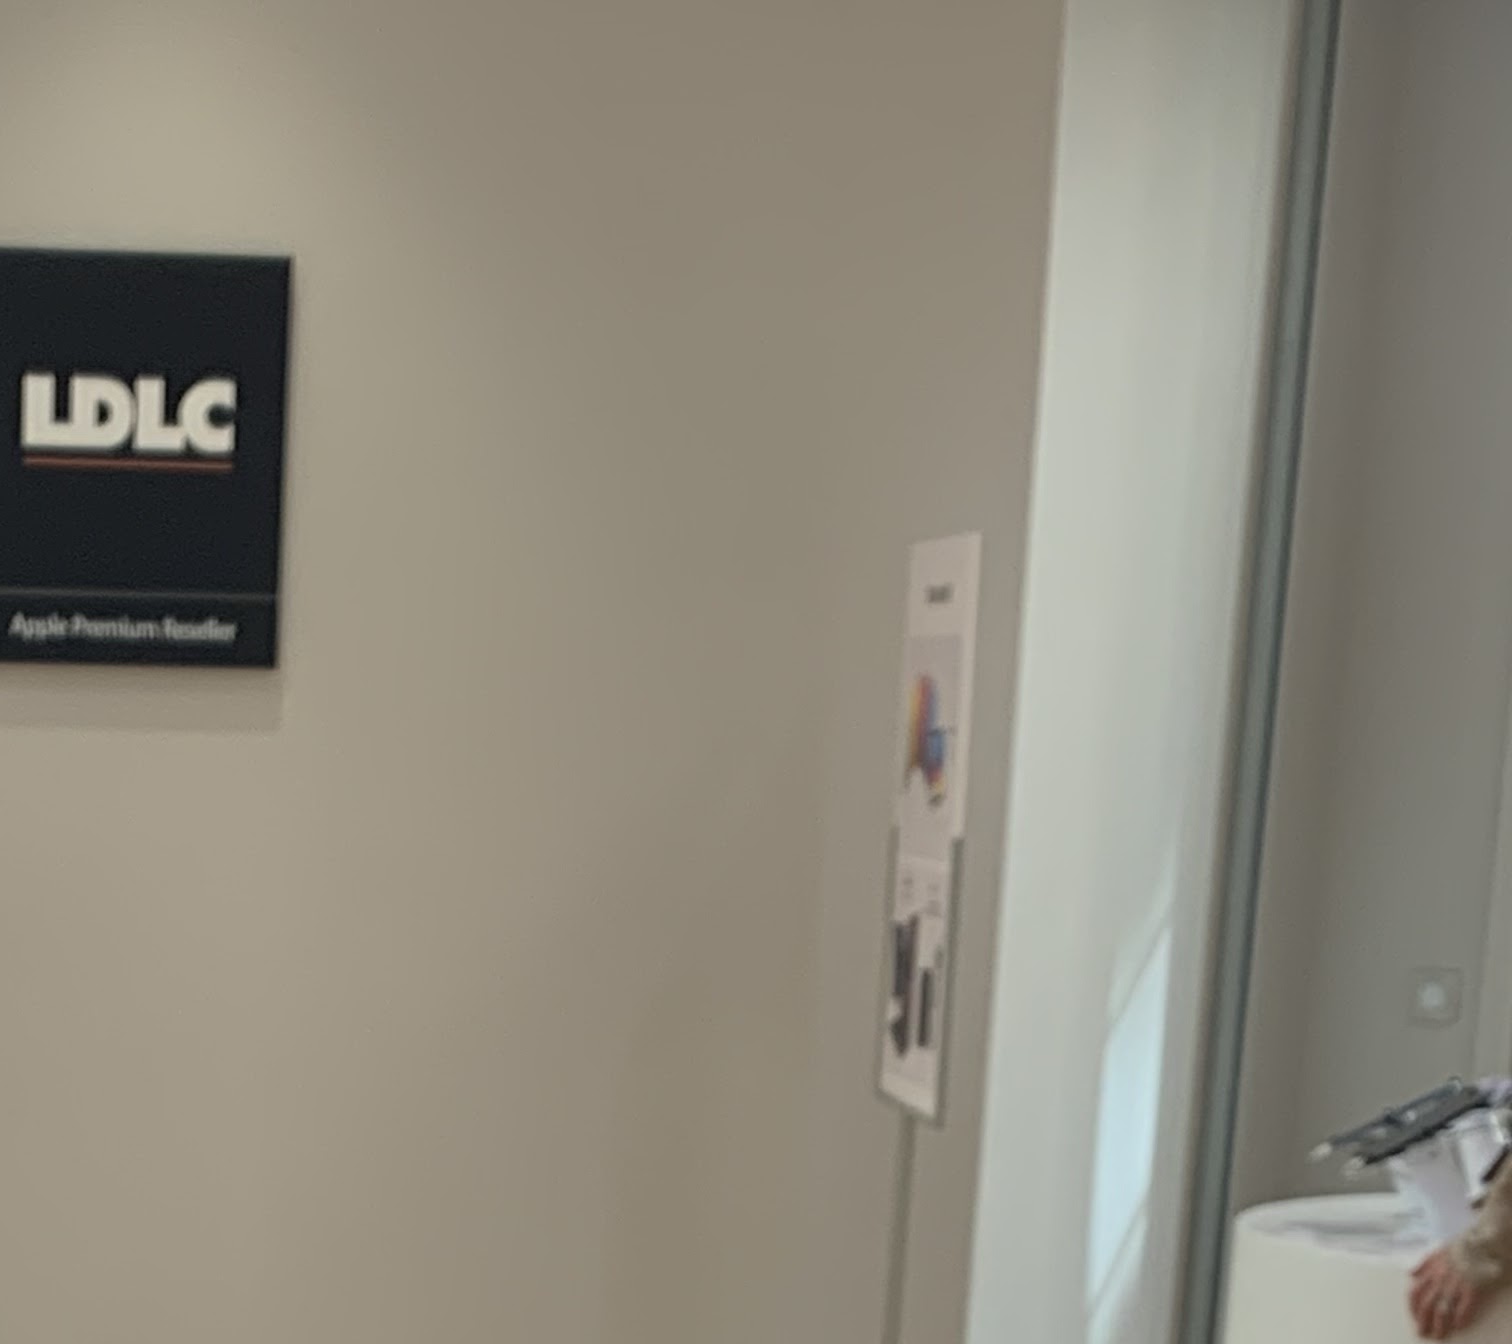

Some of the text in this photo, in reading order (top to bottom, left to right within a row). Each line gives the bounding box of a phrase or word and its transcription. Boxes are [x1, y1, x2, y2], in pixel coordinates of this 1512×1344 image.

[20, 371, 238, 454] LDLC
[8, 611, 237, 644] Apple Premium Reseller
